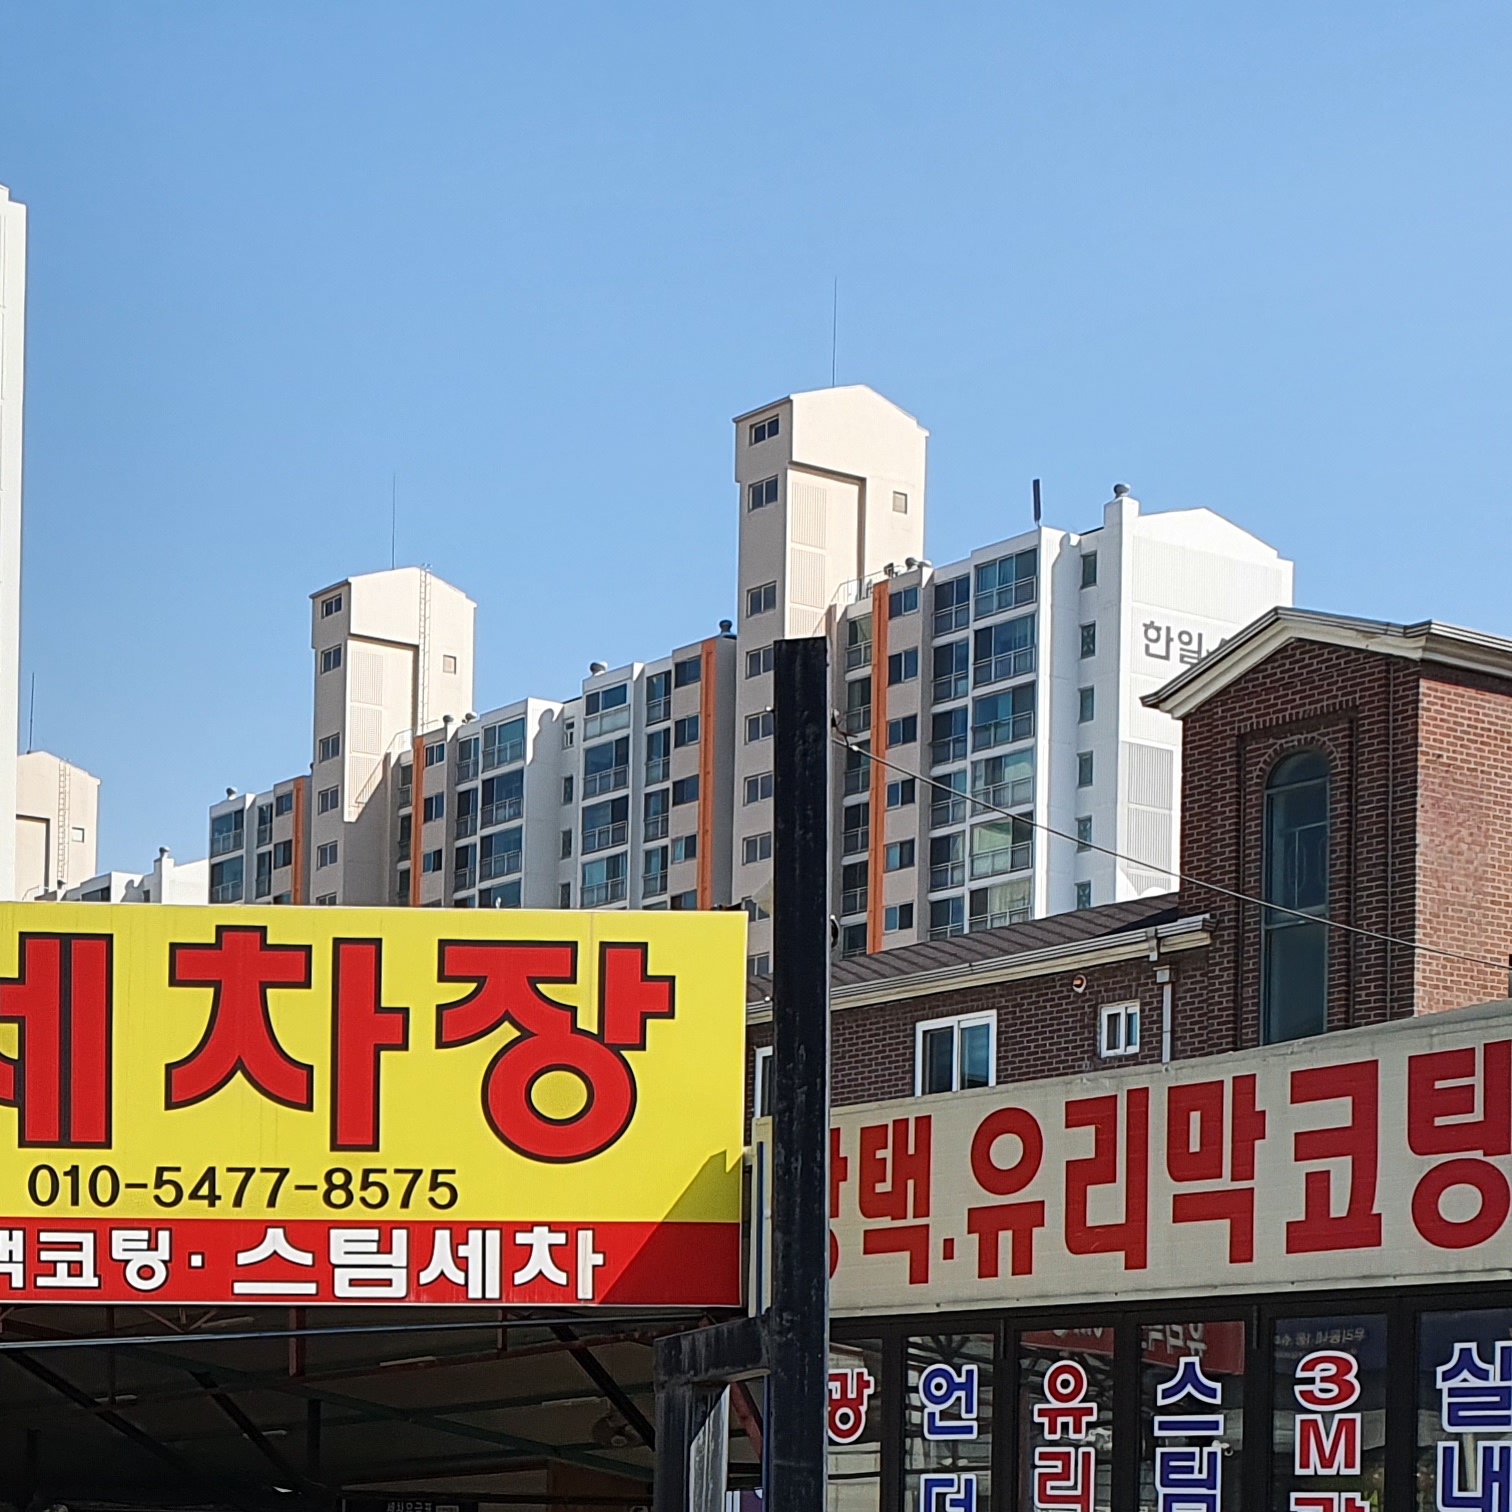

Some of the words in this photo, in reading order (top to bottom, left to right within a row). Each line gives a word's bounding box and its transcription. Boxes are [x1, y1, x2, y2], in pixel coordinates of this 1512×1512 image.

[1142, 620, 1231, 667] 한일
[28, 1163, 458, 1211] 010-5477-8575
[232, 1225, 604, 1300] 스팀세차
